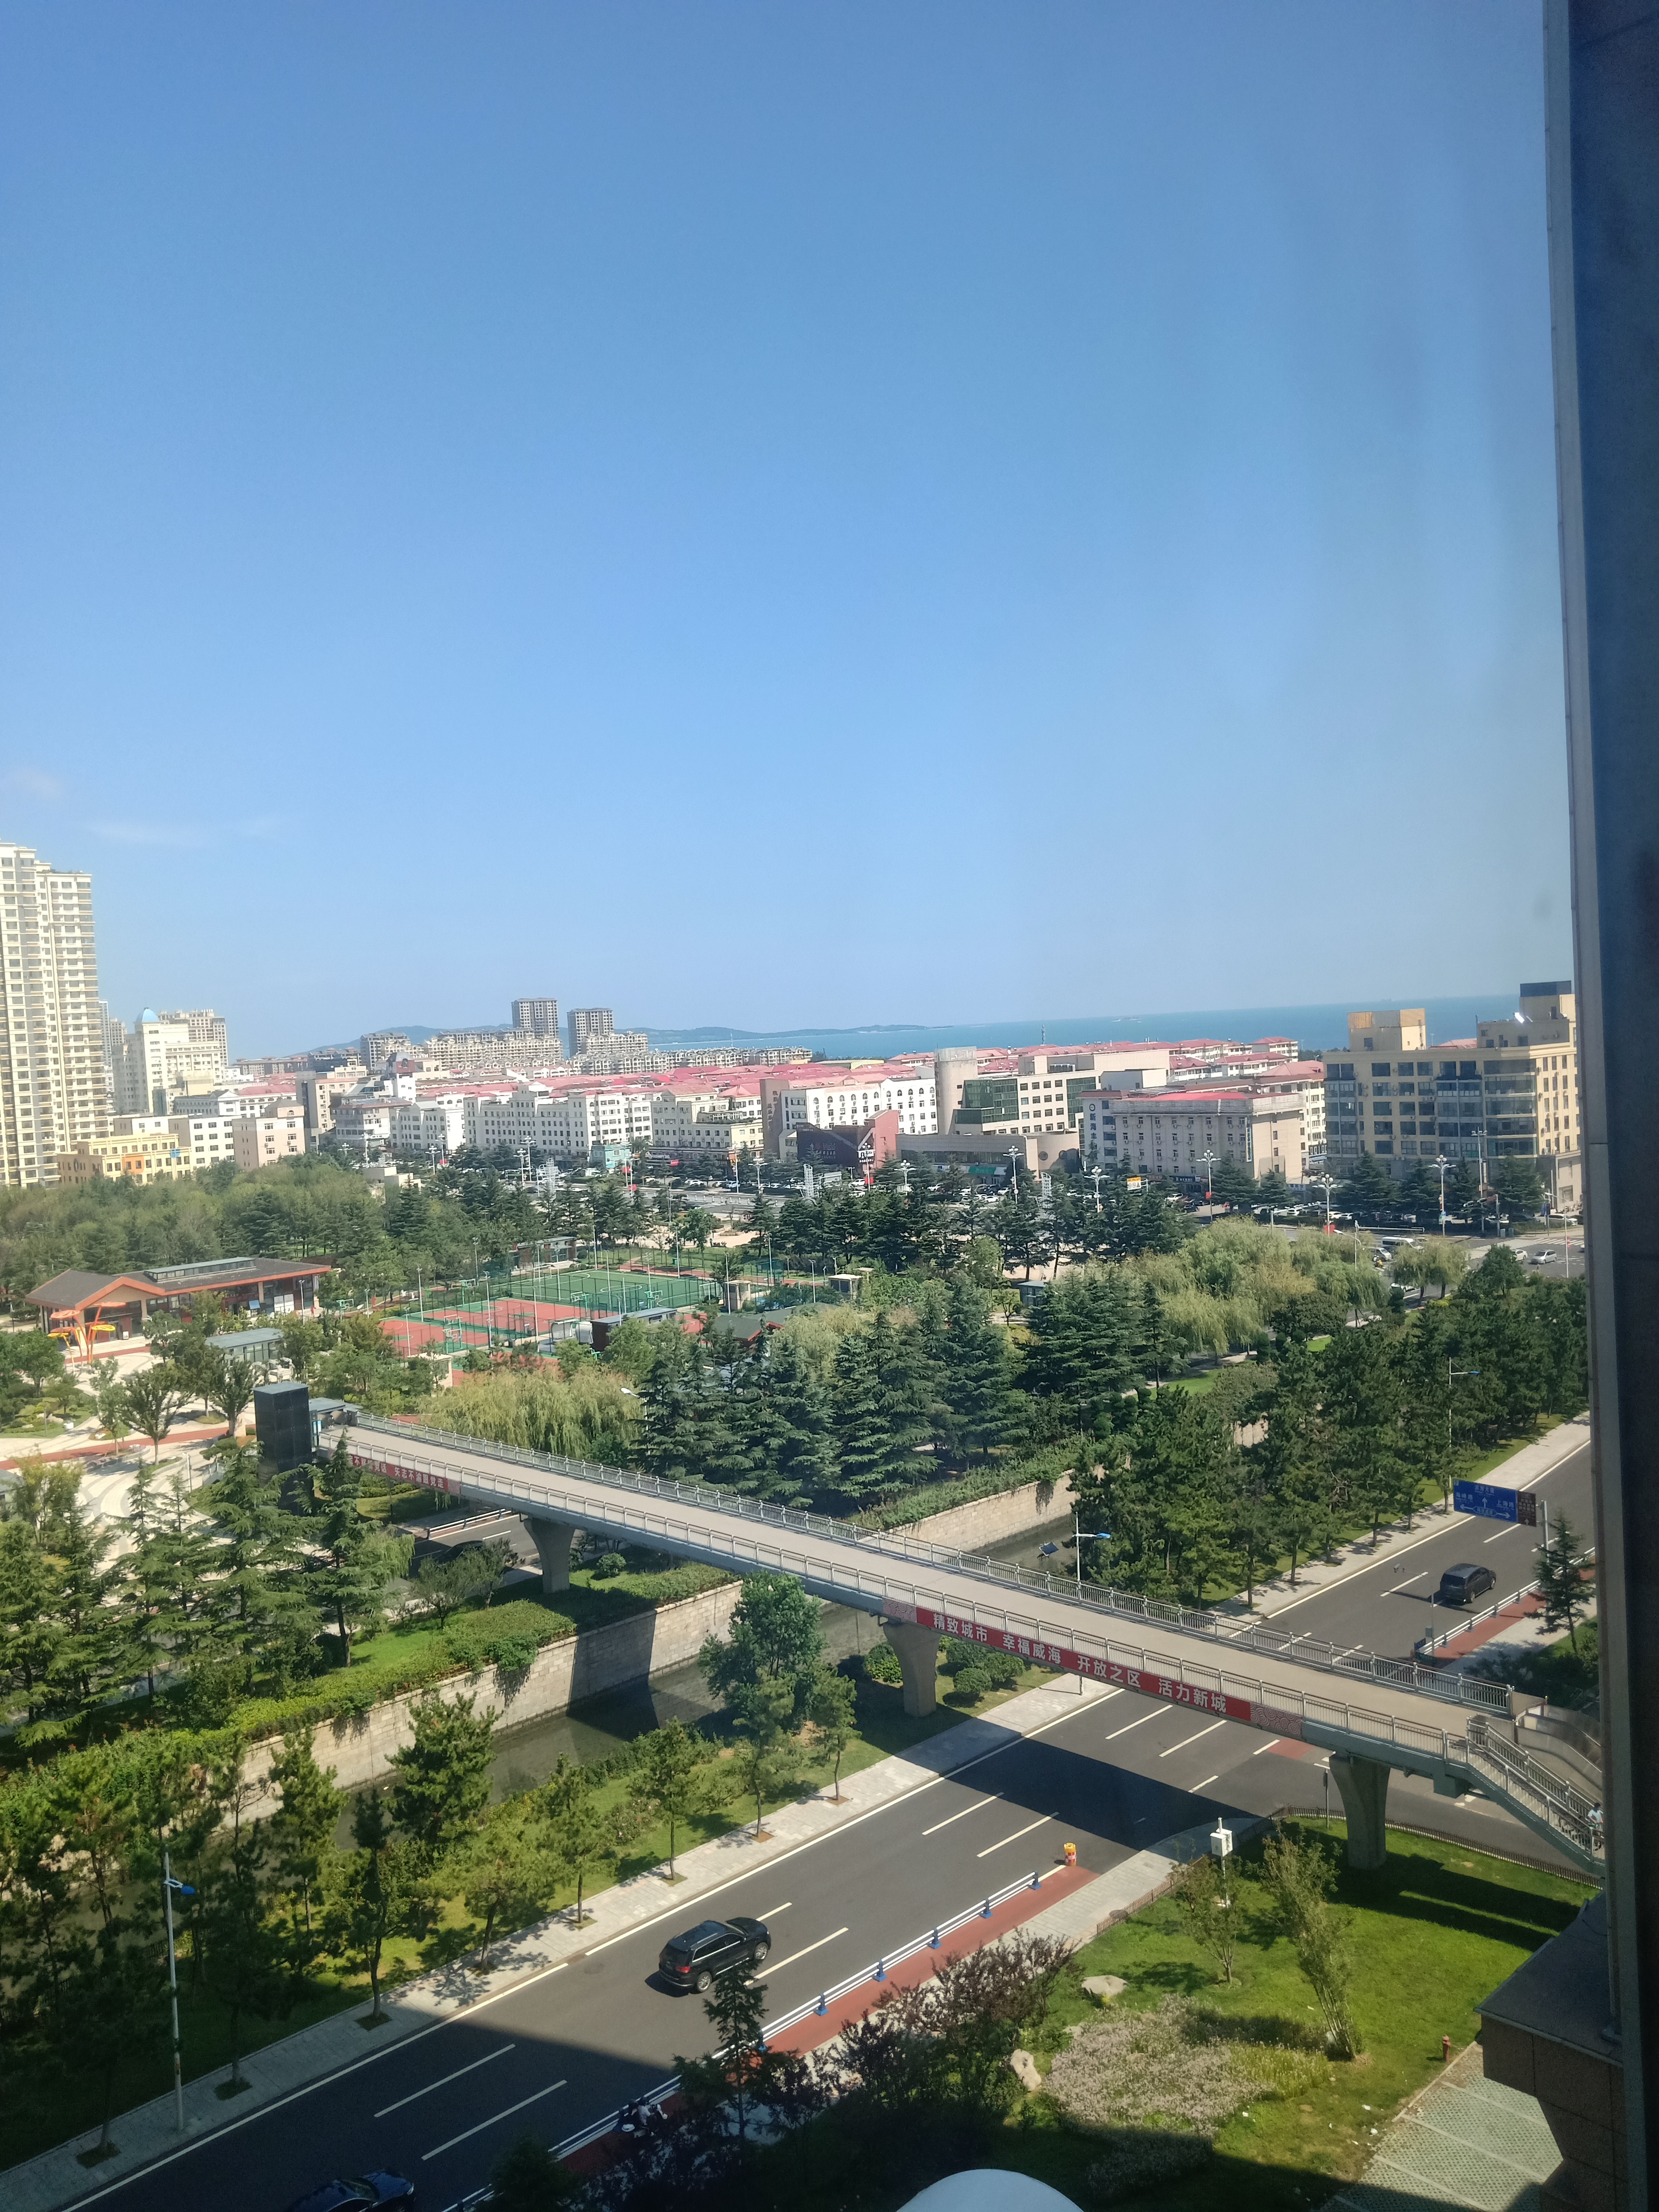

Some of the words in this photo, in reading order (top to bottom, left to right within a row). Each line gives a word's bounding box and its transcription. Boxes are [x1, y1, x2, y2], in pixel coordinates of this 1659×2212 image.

[394, 1466, 444, 1488] 矢志不渝跟党走
[933, 1613, 987, 1642] 精致城市
[1002, 1634, 1061, 1664] 幸福威海
[1078, 1655, 1141, 1687] 开放之区
[1159, 1678, 1226, 1712] 活力新城
